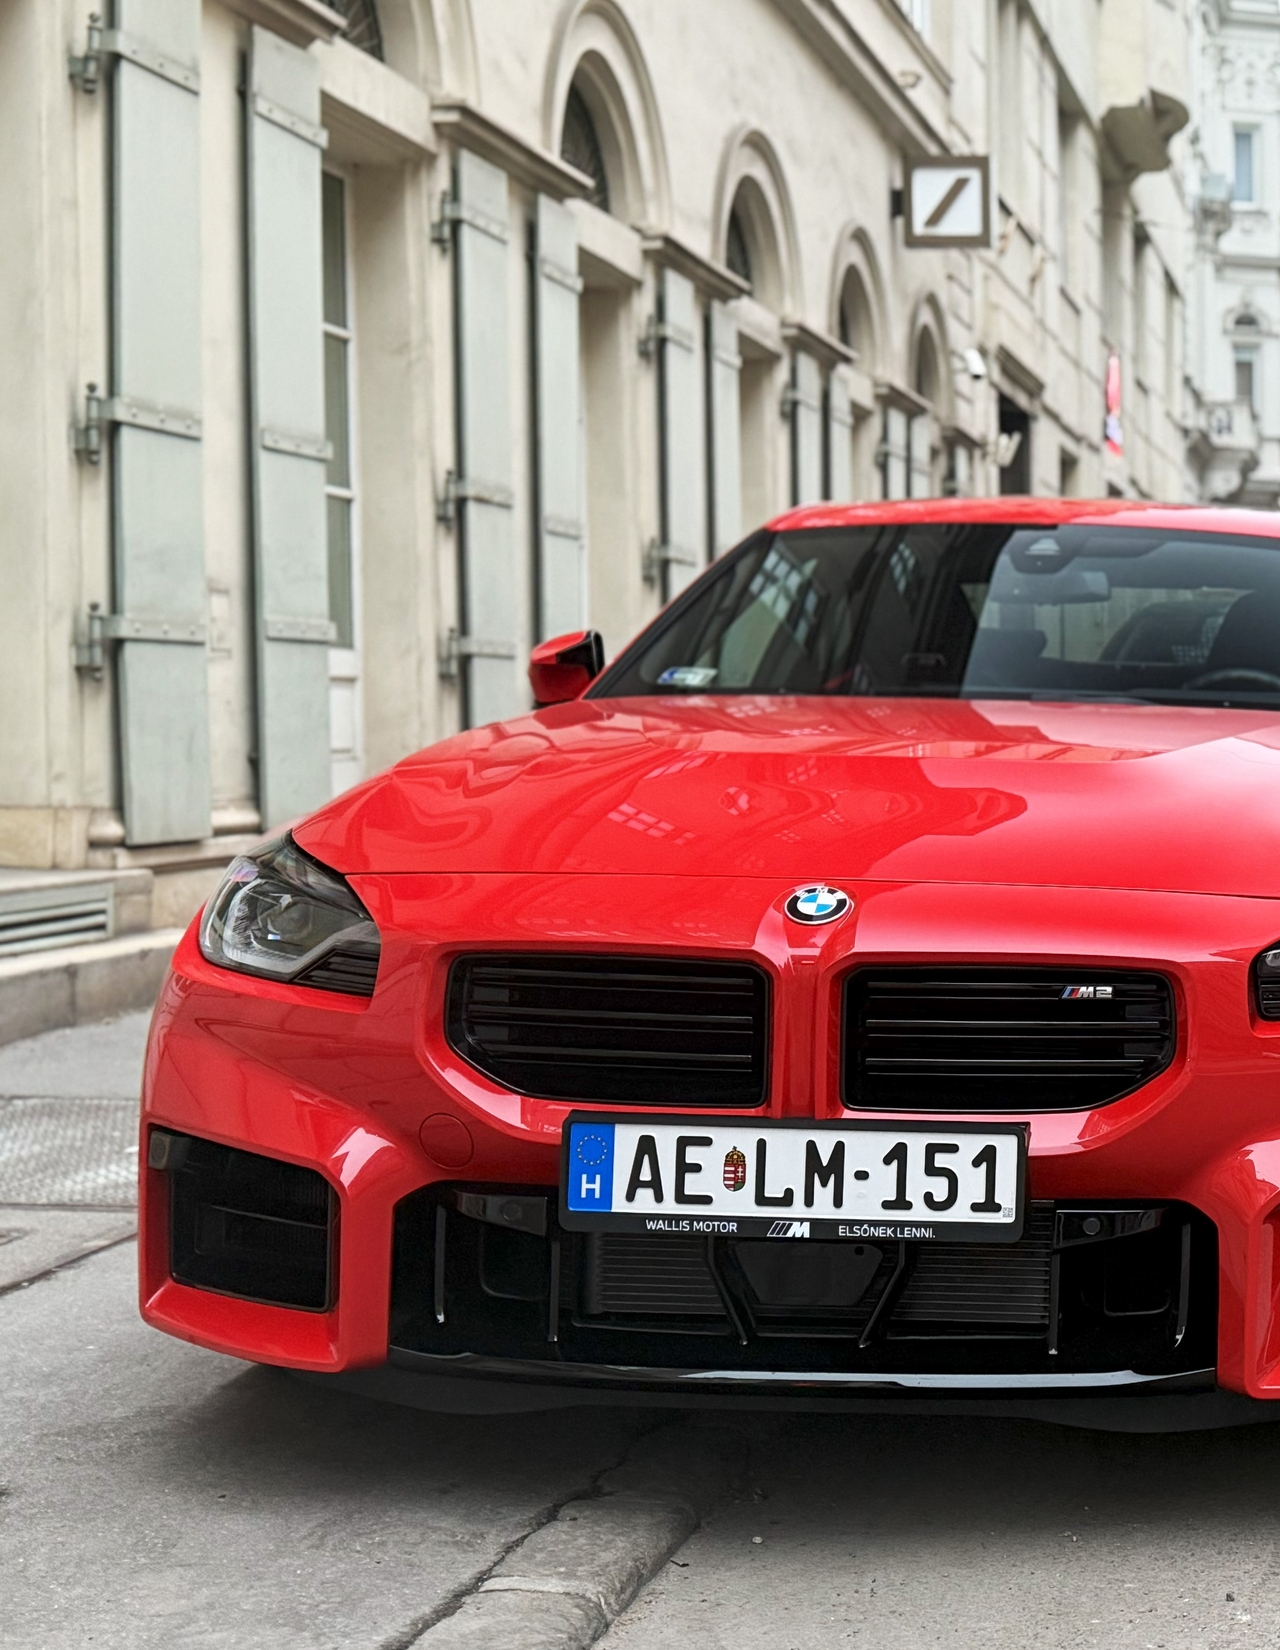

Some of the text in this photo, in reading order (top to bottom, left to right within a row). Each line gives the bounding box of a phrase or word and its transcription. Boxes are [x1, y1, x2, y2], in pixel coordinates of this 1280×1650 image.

[580, 1173, 601, 1199] H
[754, 1138, 1003, 1214] LM-151
[645, 1219, 690, 1232] WALLIS
[693, 1221, 738, 1233] MOTOR
[838, 1224, 895, 1238] ELSŐNEK
[896, 1226, 936, 1239] LENNI.
